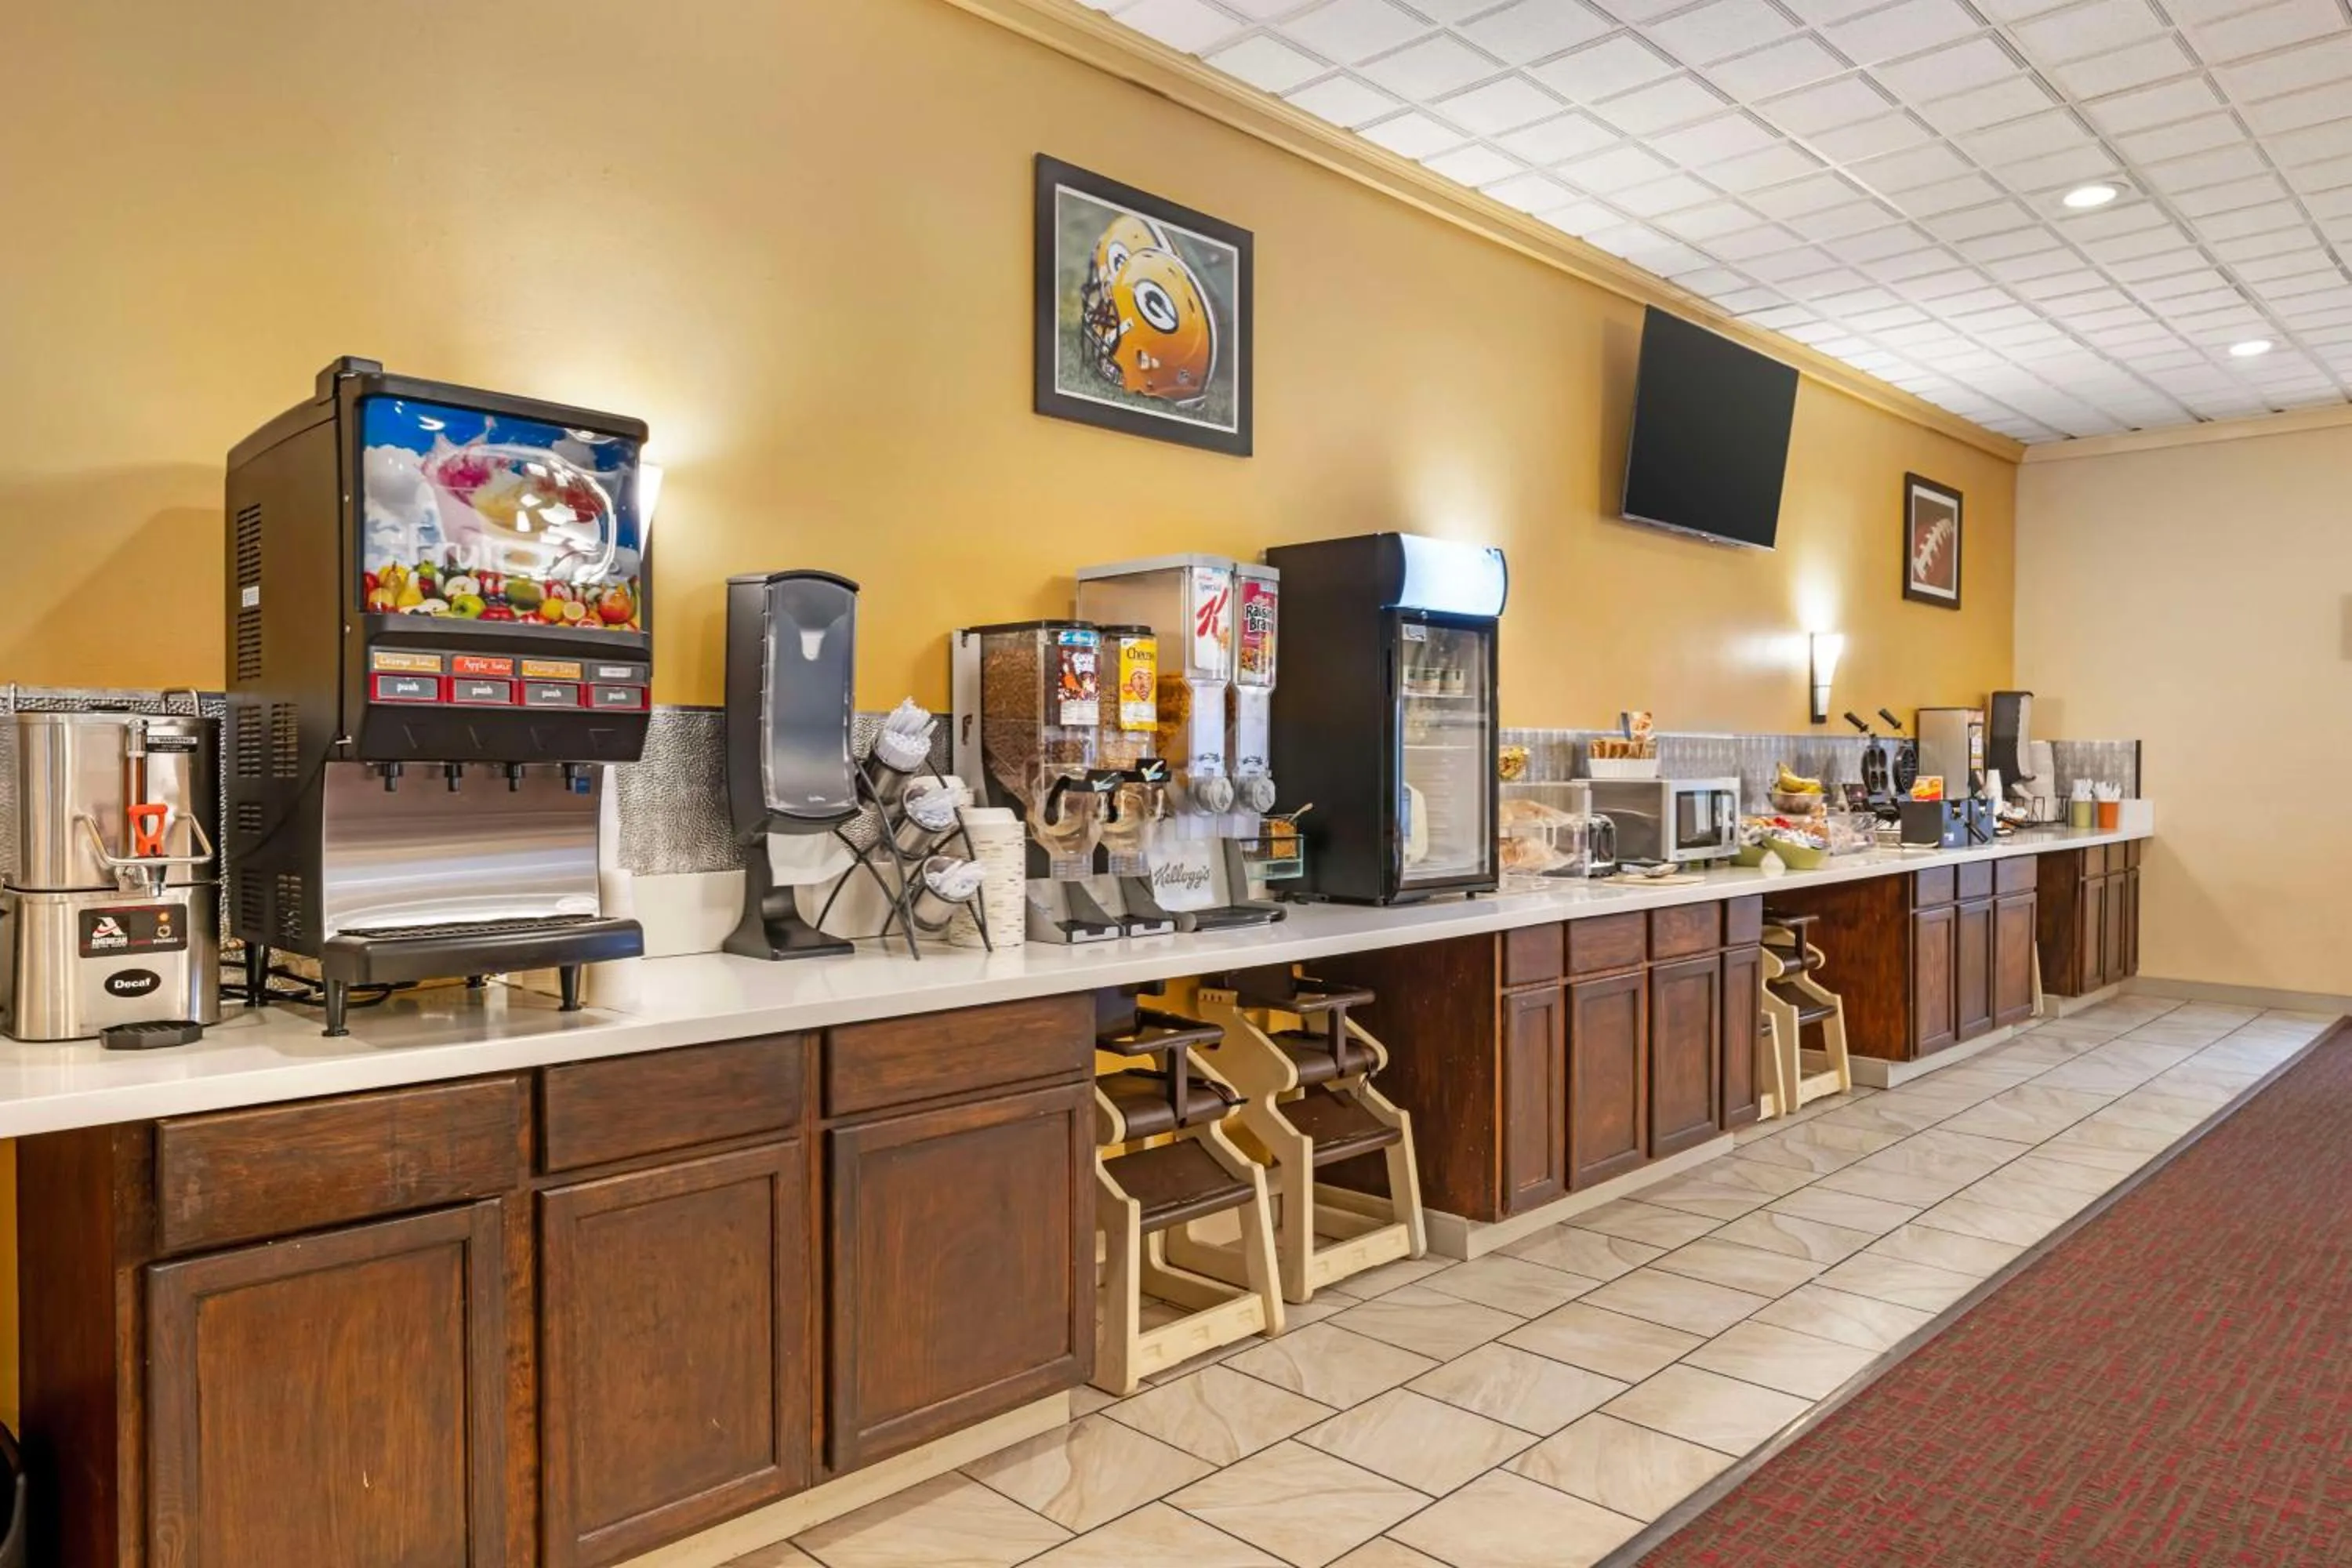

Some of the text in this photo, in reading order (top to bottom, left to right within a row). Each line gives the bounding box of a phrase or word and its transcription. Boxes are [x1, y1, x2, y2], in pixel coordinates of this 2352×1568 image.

[1196, 588, 1229, 637] K
[397, 681, 419, 694] push
[472, 685, 493, 696] push
[542, 688, 562, 699] push
[608, 691, 627, 701] push
[1154, 862, 1210, 890] Kellogg's
[114, 978, 151, 989] Decaf
